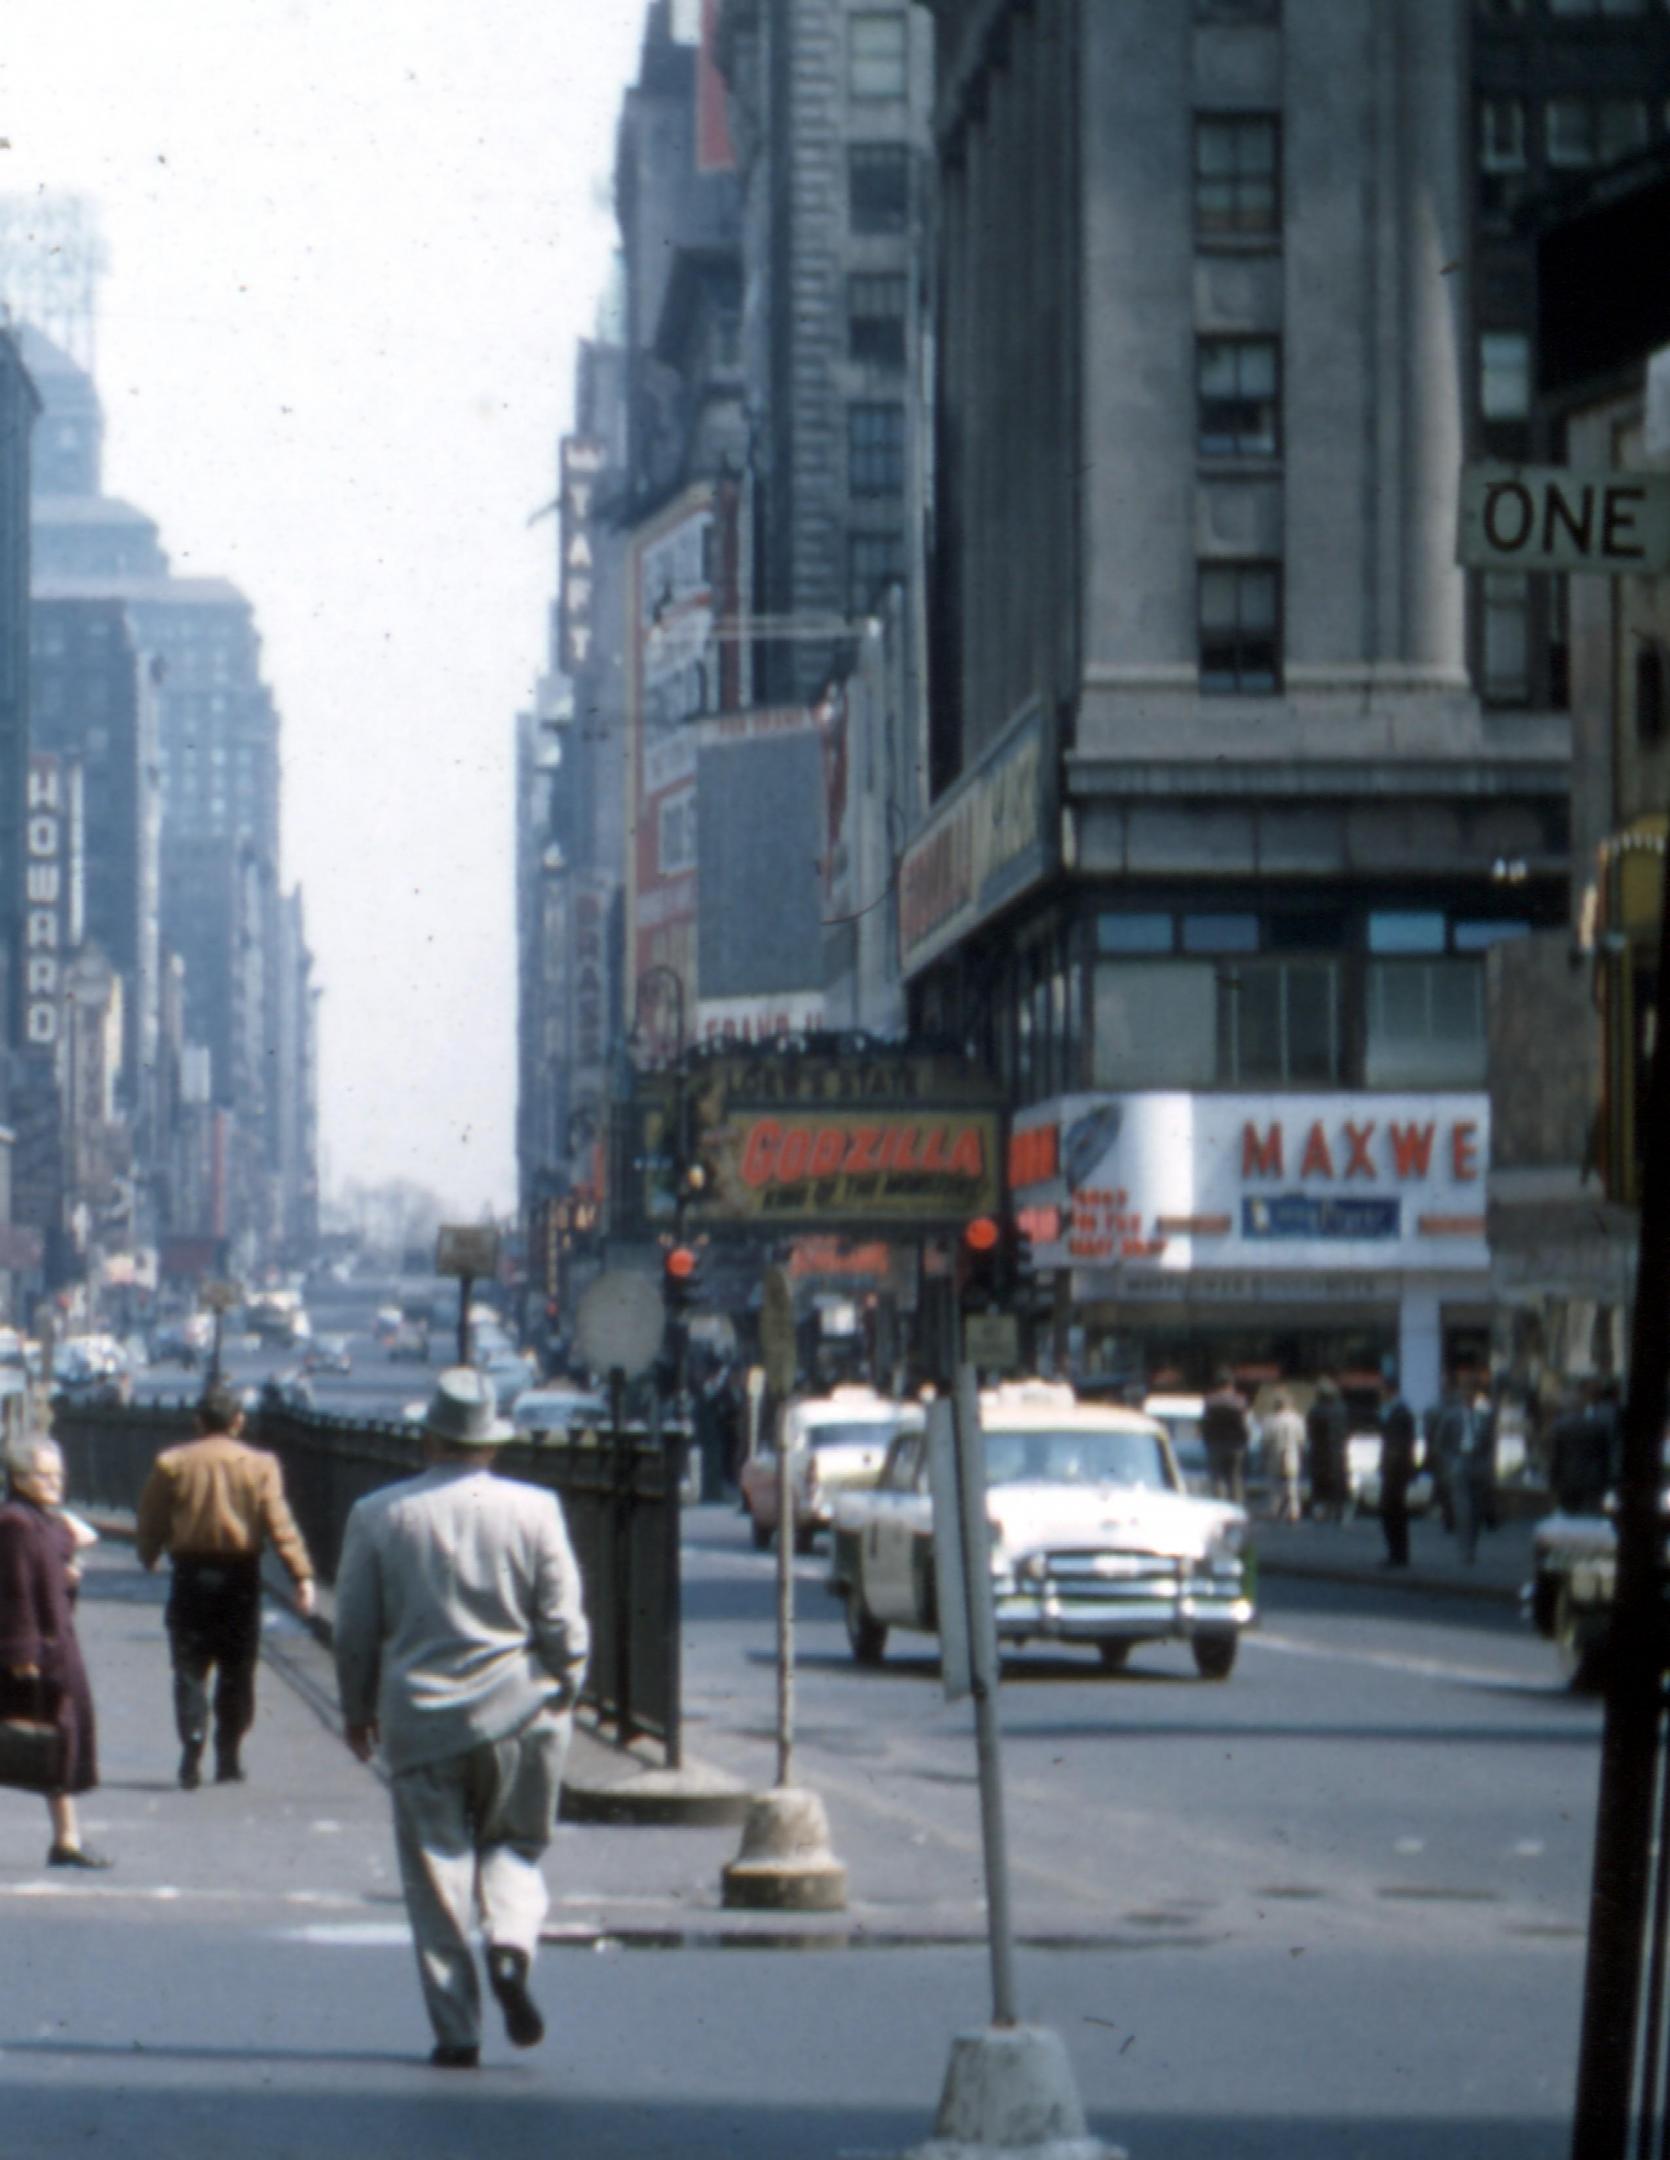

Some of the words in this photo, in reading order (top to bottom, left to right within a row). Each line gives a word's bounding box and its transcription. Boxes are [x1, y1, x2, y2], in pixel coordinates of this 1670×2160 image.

[1483, 481, 1647, 557] ONE
[26, 767, 60, 1043] HOWARD
[741, 1118, 984, 1189] GODZILLA
[1241, 1119, 1478, 1180] MAXWE
